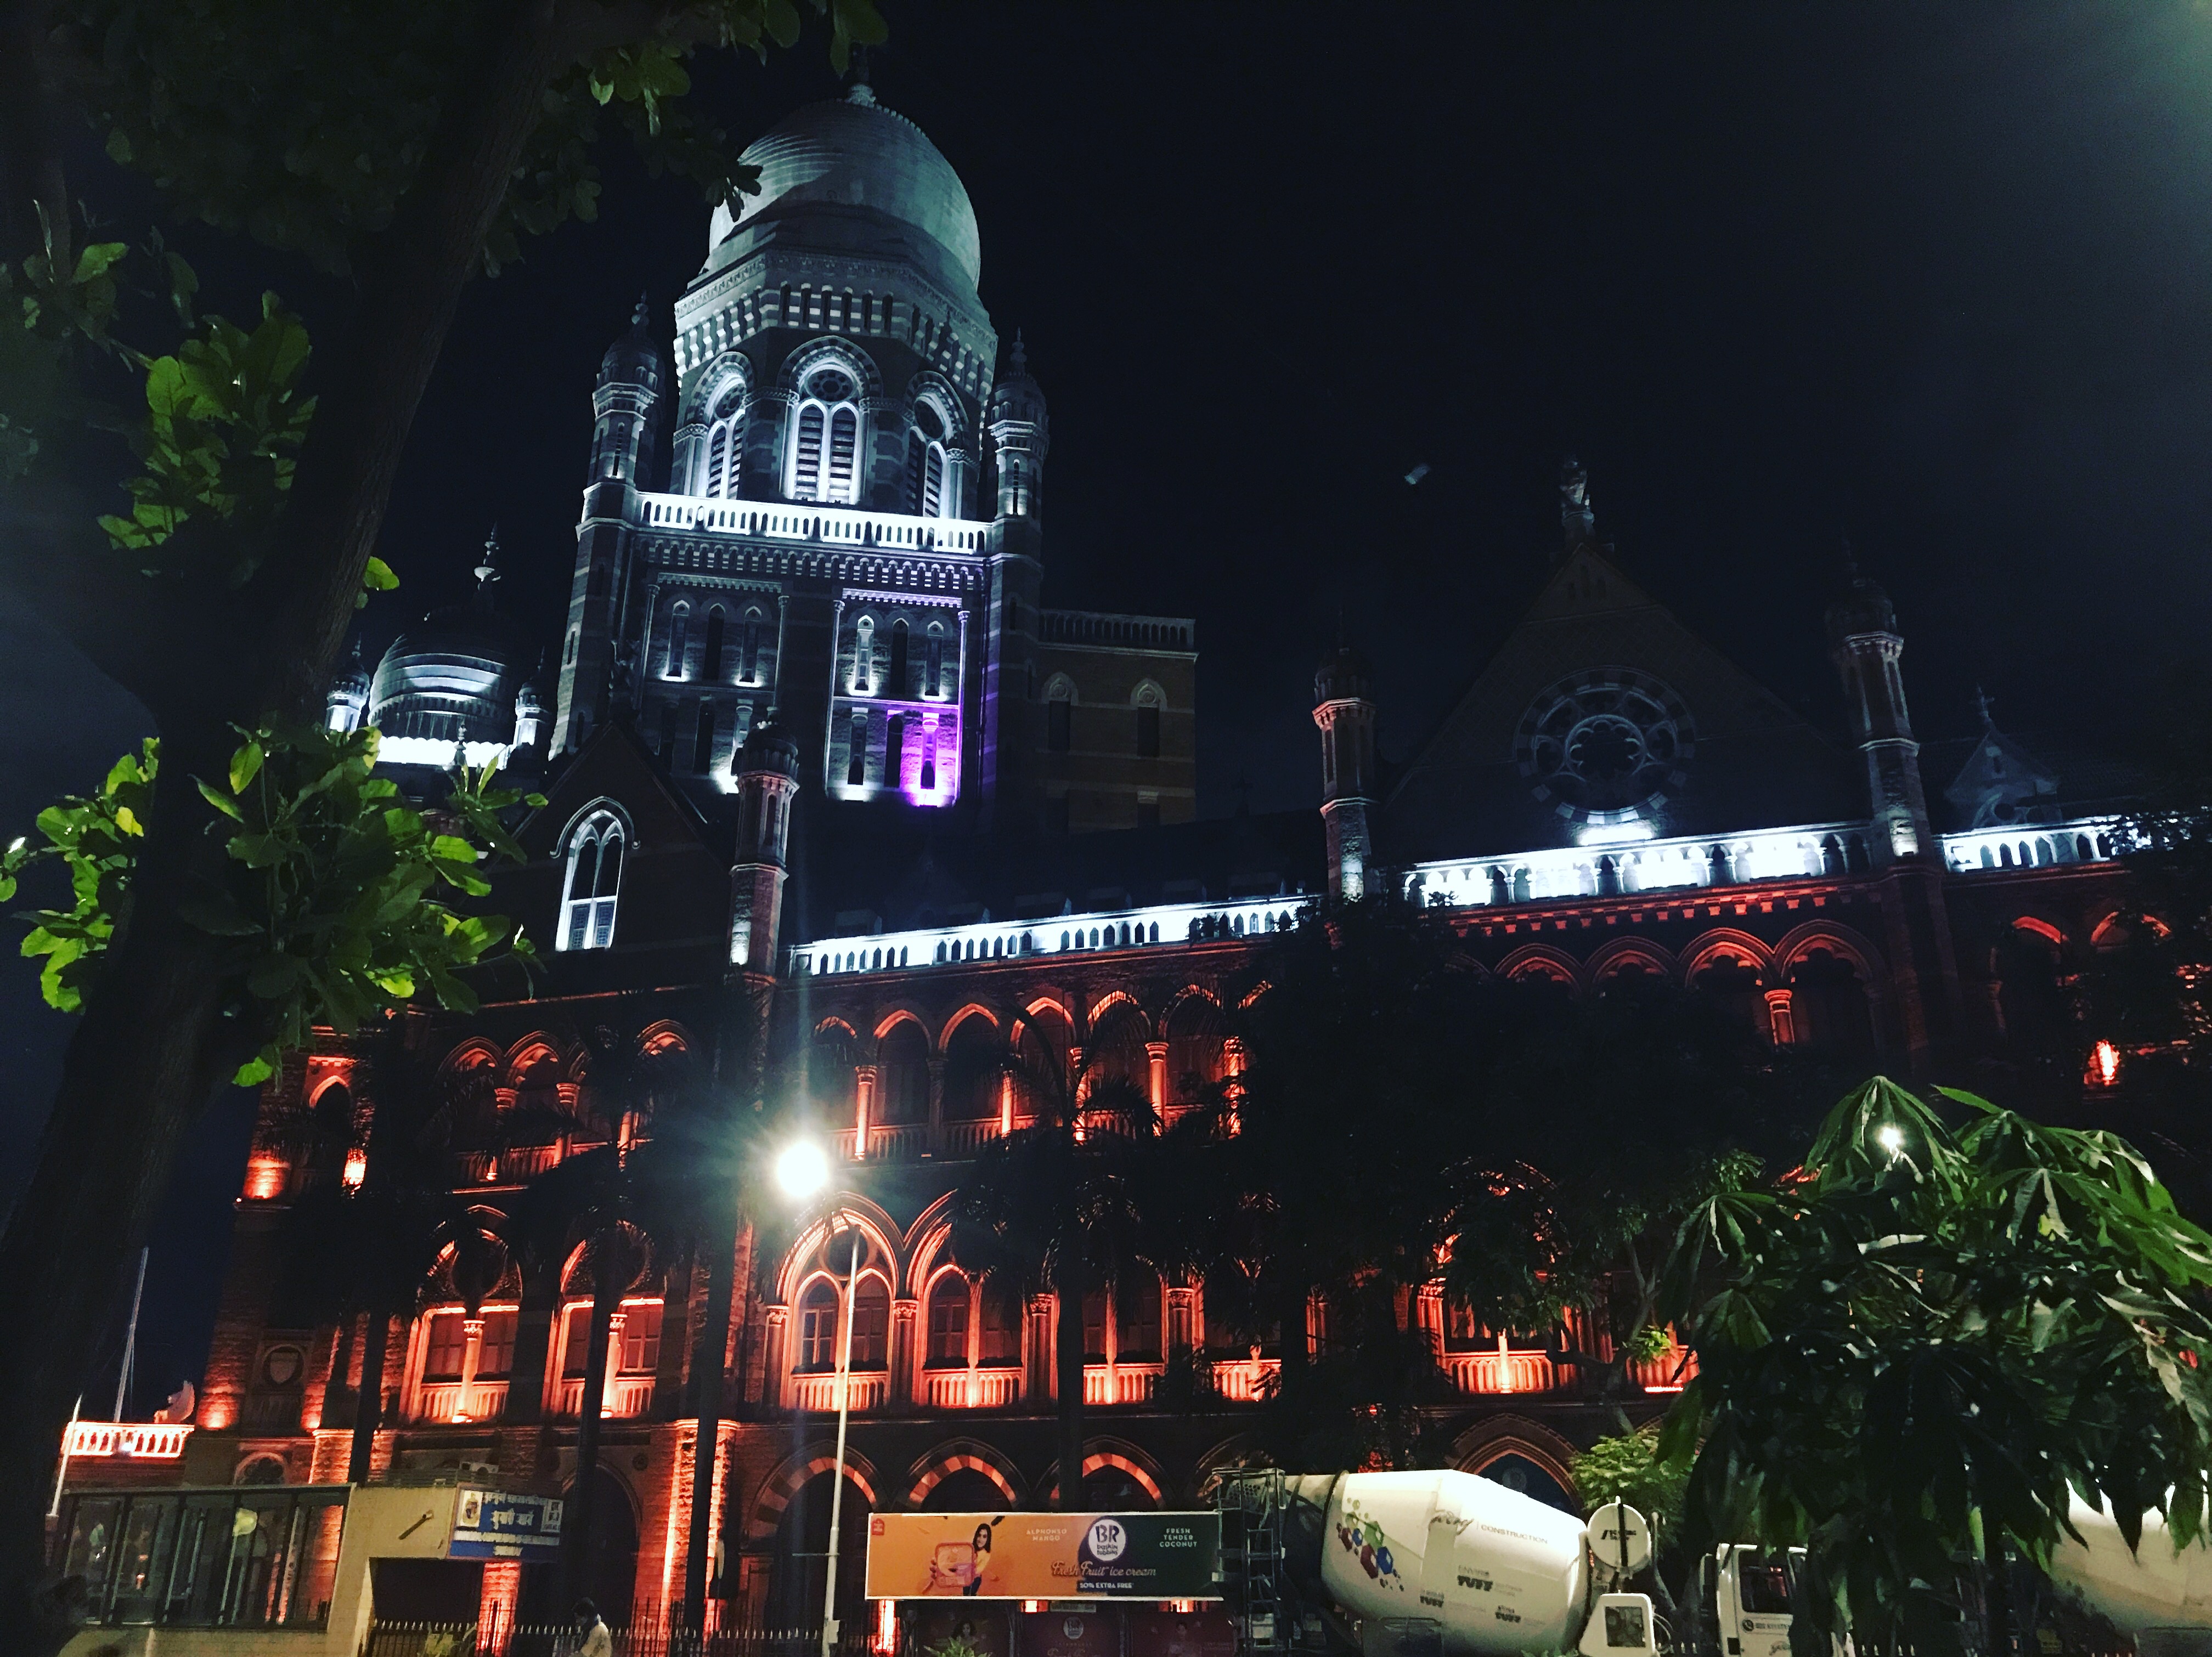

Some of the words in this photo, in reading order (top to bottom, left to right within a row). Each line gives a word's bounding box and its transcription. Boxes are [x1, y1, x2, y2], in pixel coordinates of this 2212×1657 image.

[1095, 1524, 1120, 1543] BR
[1481, 1524, 1548, 1544] CONSTRUCTION
[1052, 1560, 1079, 1576] Fresh
[1080, 1560, 1106, 1576] Fruit
[1109, 1566, 1124, 1576] ice
[1125, 1568, 1156, 1576] cream
